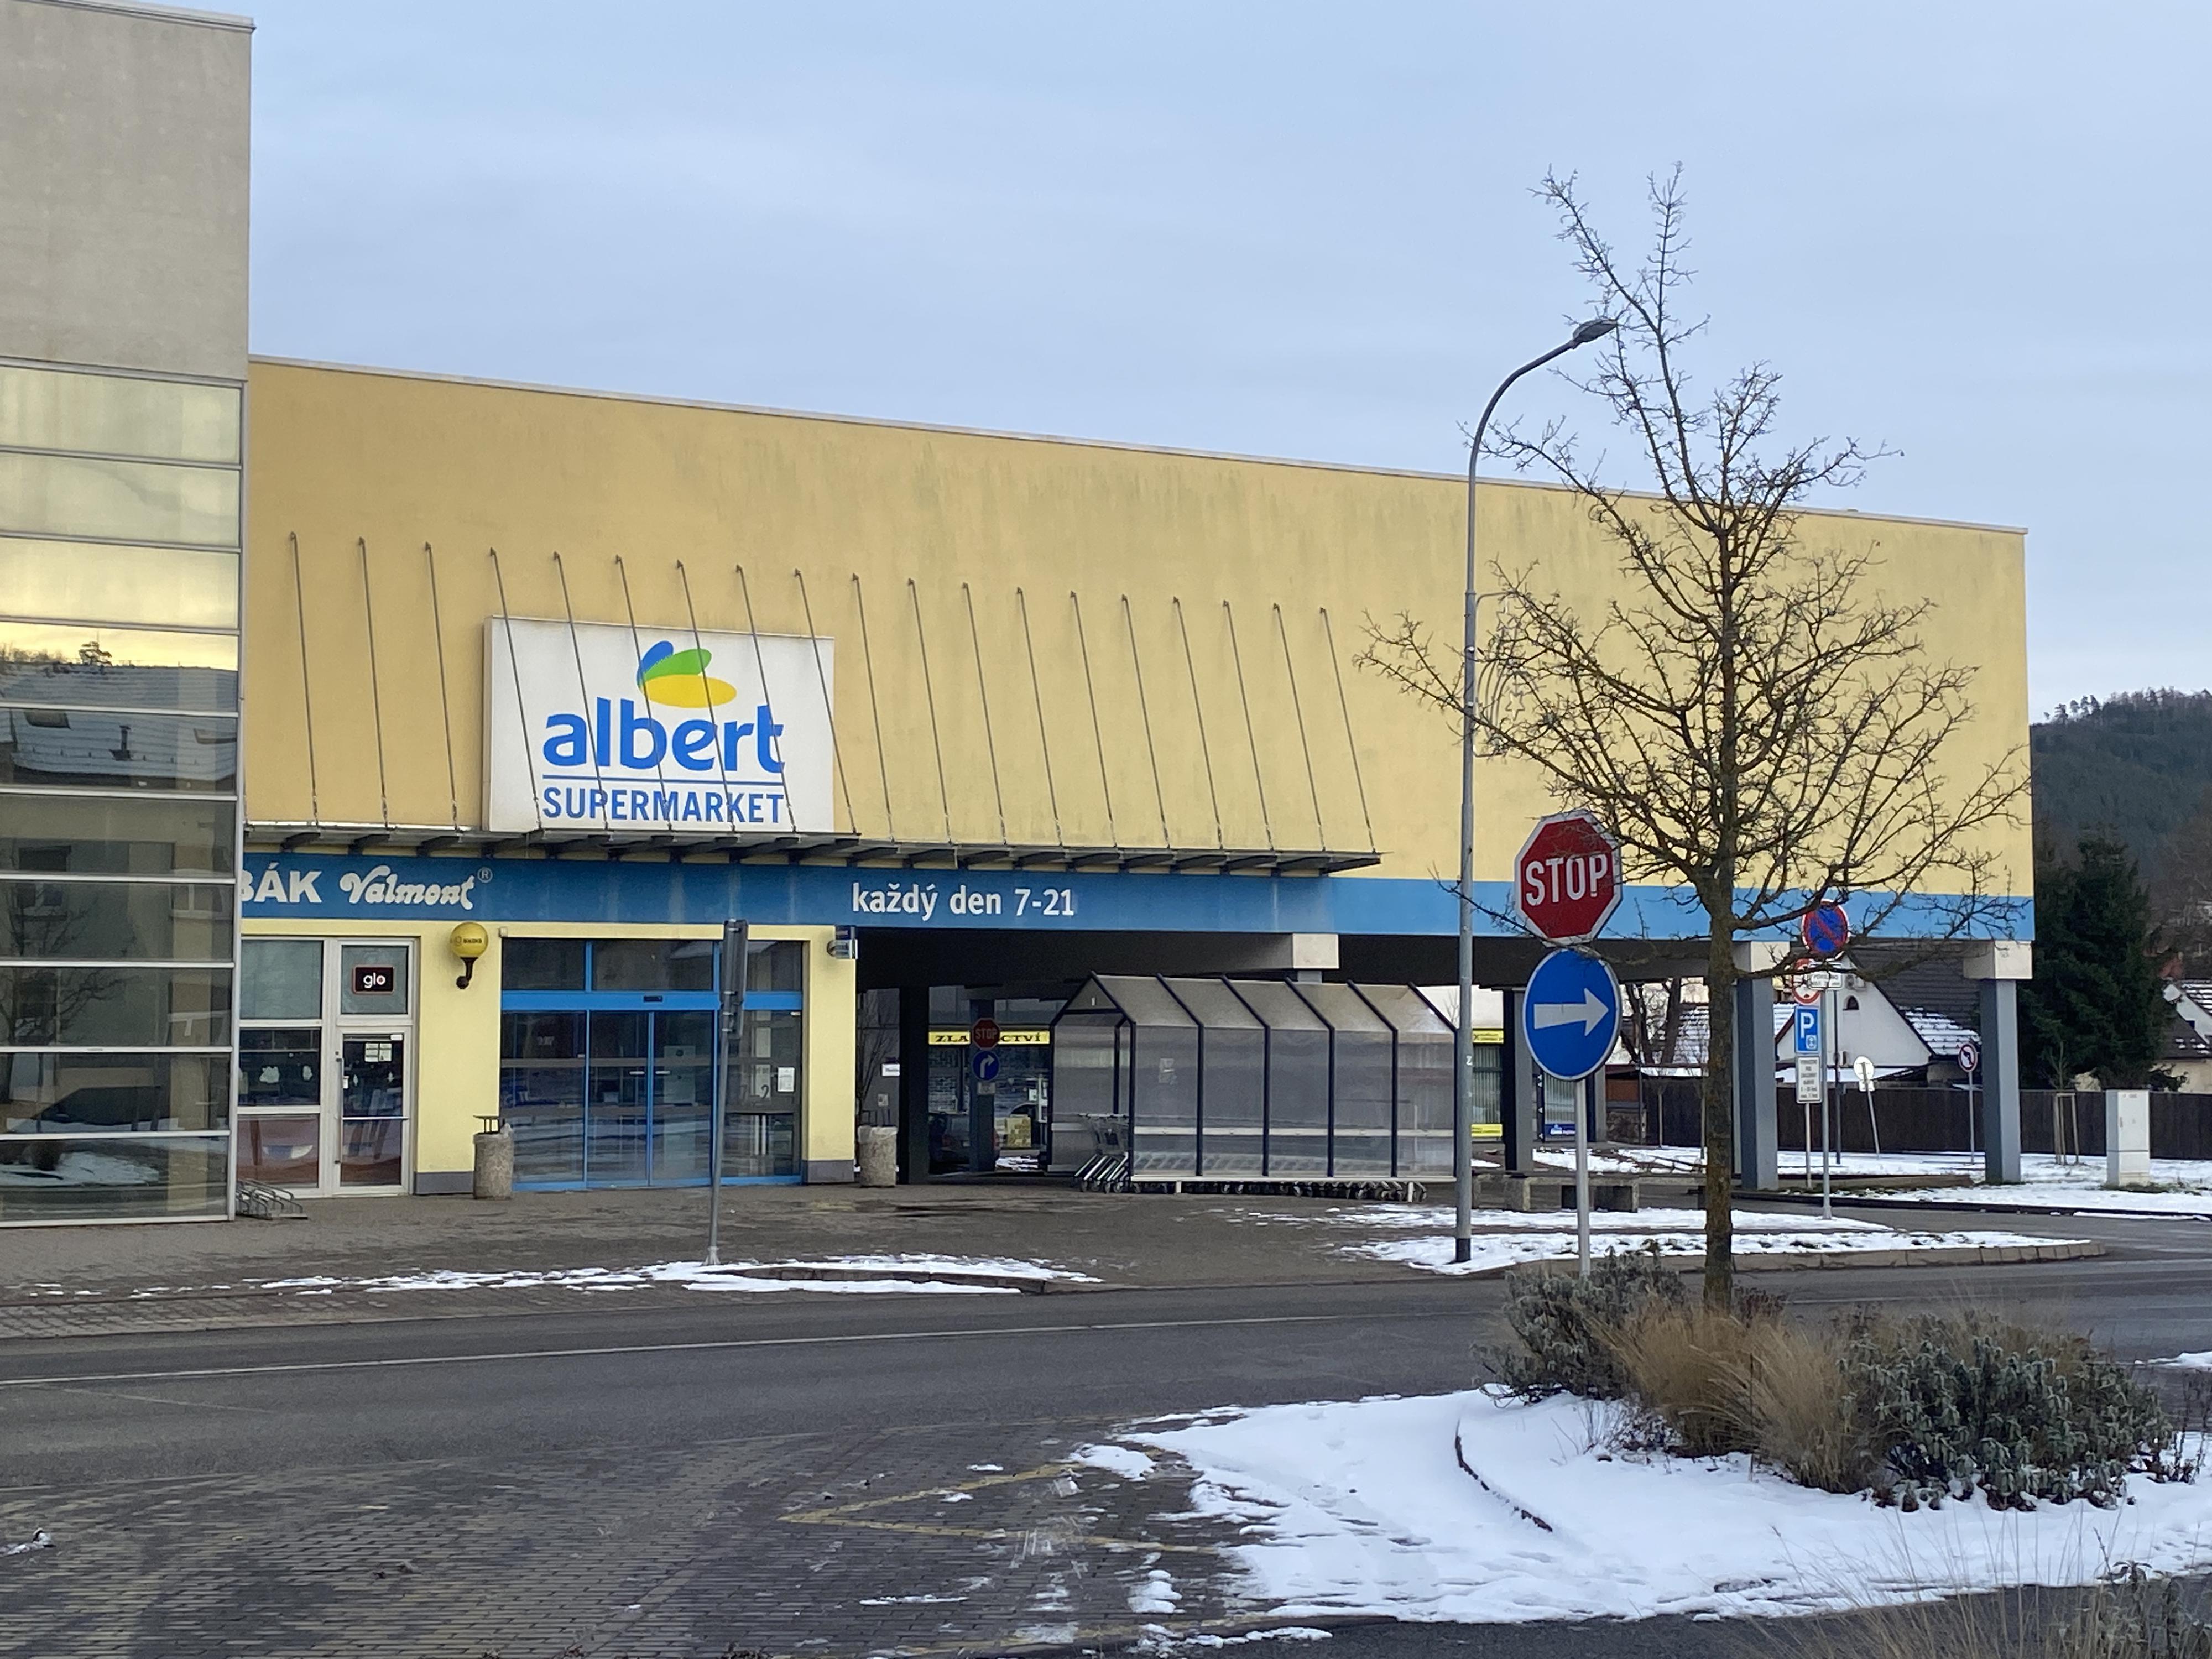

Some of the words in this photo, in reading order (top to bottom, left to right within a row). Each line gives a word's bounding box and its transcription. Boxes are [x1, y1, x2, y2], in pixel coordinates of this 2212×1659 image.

[543, 697, 785, 773] albert
[542, 787, 784, 823] SUPERMARKET
[1526, 854, 1608, 906] STOP
[852, 883, 938, 921] každý
[950, 885, 1001, 915] den
[1015, 888, 1074, 916] 7-21
[363, 972, 385, 988] glo
[935, 1032, 1041, 1042] ZLACTVÍ
[975, 1027, 998, 1040] STOP
[1801, 1012, 1814, 1039] P
